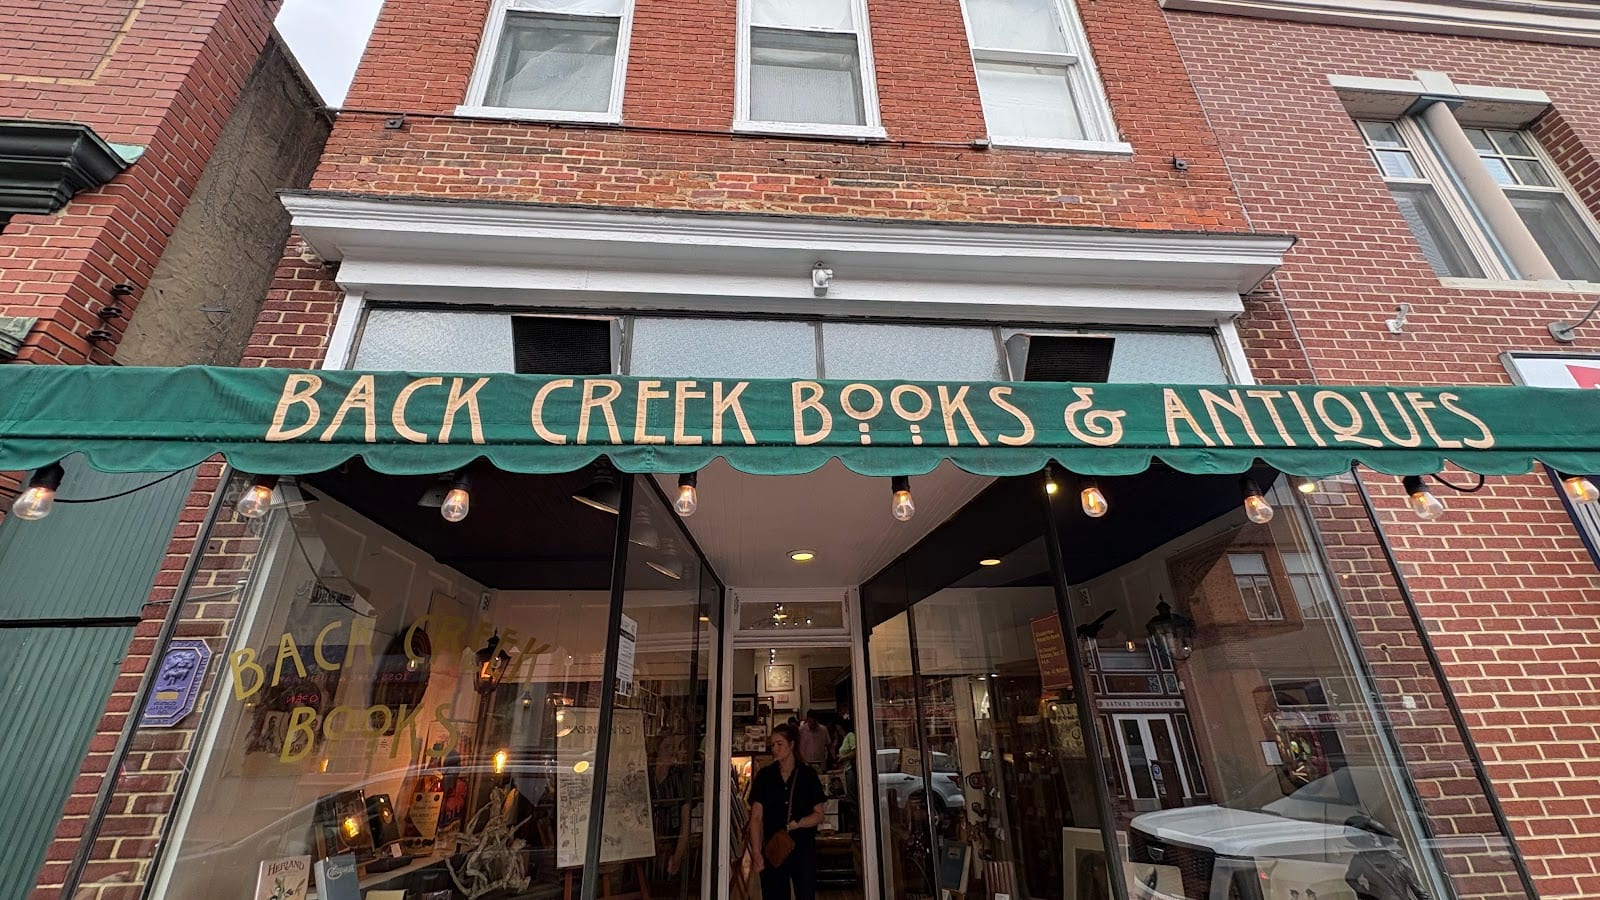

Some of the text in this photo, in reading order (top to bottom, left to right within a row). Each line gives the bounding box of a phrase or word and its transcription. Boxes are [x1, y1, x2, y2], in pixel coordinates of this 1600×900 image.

[265, 373, 1496, 450] BACK CREEK BOOKS & ANTIQUES
[229, 616, 377, 701] BACK
[404, 612, 551, 690] CREEK
[280, 703, 460, 763] BOOKS
[267, 860, 305, 876] HERLAND
